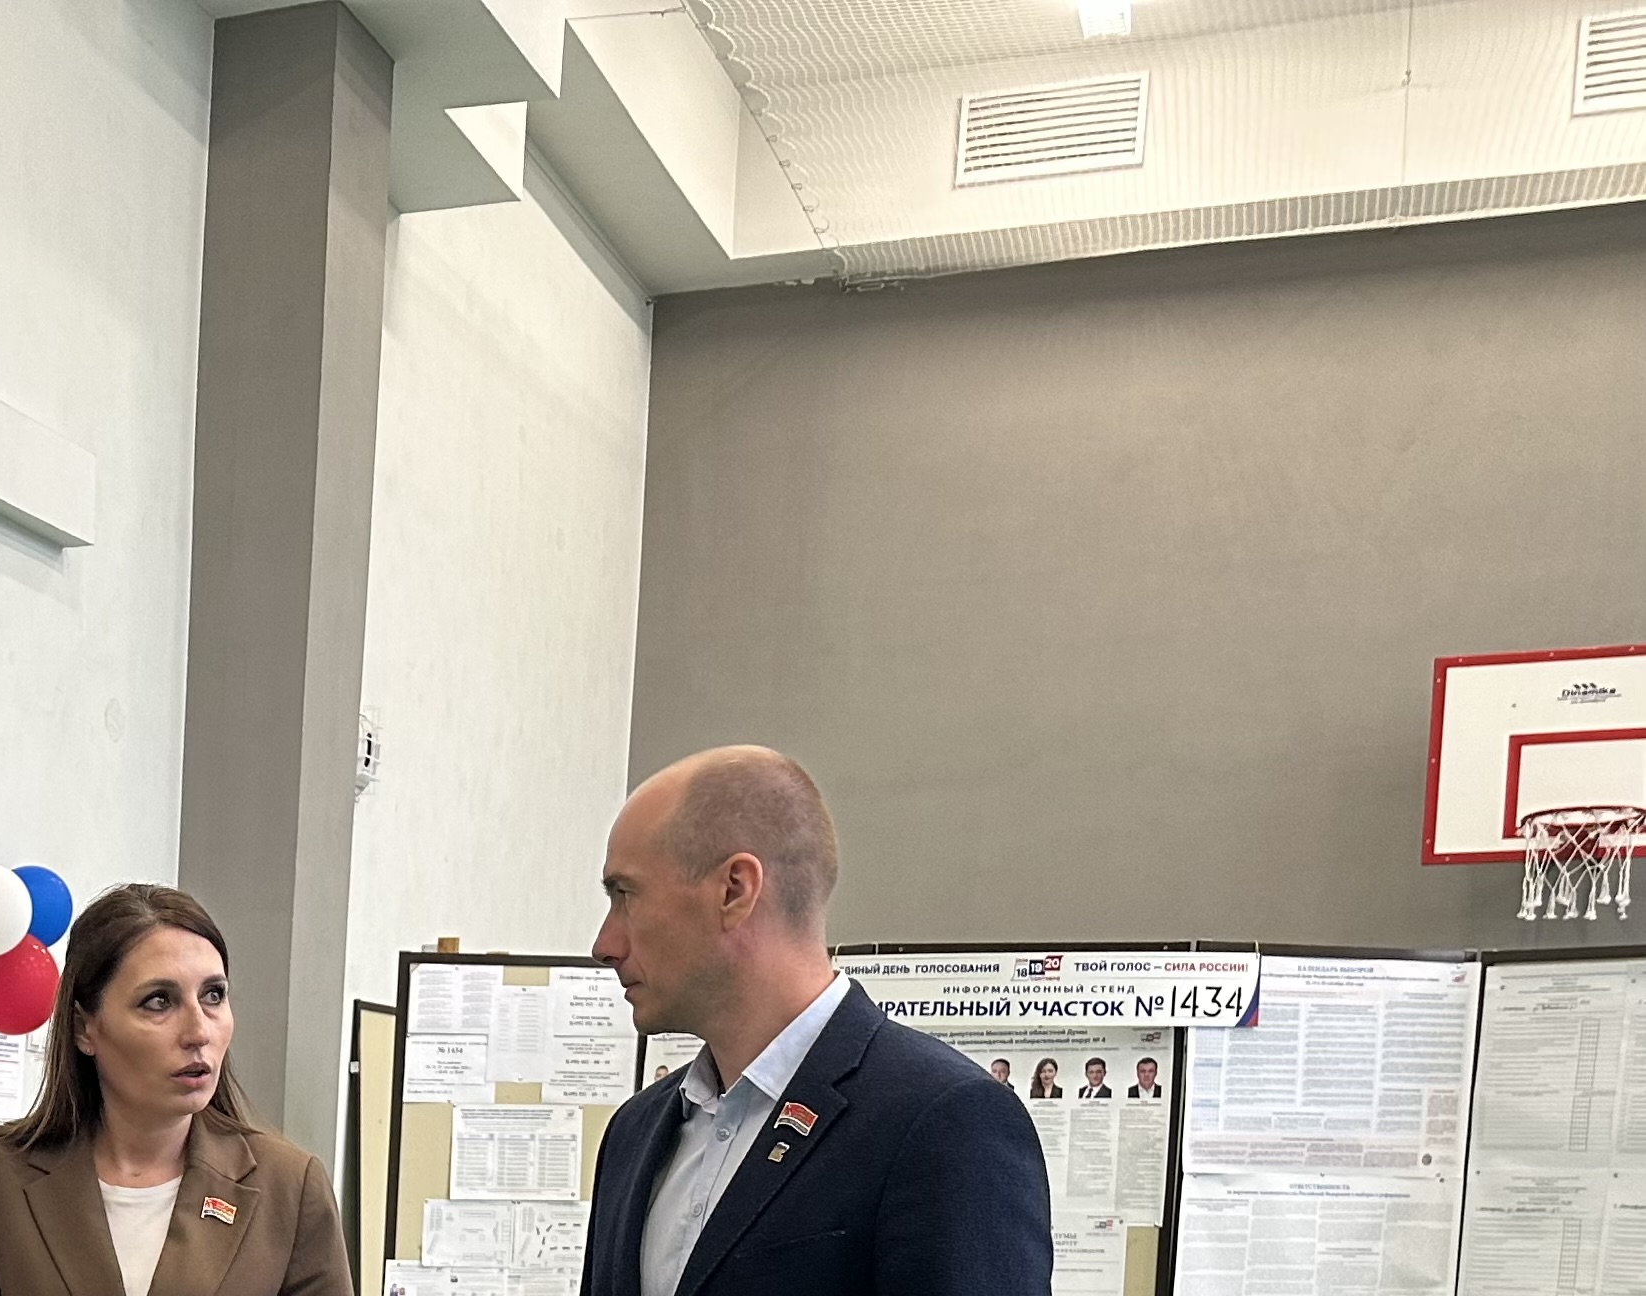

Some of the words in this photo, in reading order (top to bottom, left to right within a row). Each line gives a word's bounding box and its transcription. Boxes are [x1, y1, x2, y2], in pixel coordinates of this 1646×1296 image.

[840, 963, 880, 975] ДИННЫЙ
[882, 965, 910, 976] ДЕНЬ
[915, 964, 1000, 974] ГОЛОСОВАНИЯ
[1016, 967, 1028, 978] 18
[1044, 958, 1060, 969] 20
[1074, 960, 1107, 972] ТВОЙ
[1110, 962, 1151, 972] ГОЛОС
[1164, 962, 1196, 972] СИЛА
[1199, 962, 1249, 972] РОССИИ!
[943, 983, 1084, 994] ИНФОРМАЦИОННЫЙ
[1091, 984, 1135, 995] СТЕНД
[877, 997, 1011, 1017] ИРАТЕЛЬНЫЙ
[1018, 1001, 1124, 1017] УЧАСТОК
[1135, 996, 1164, 1017] №
[1170, 985, 1243, 1018] 1434
